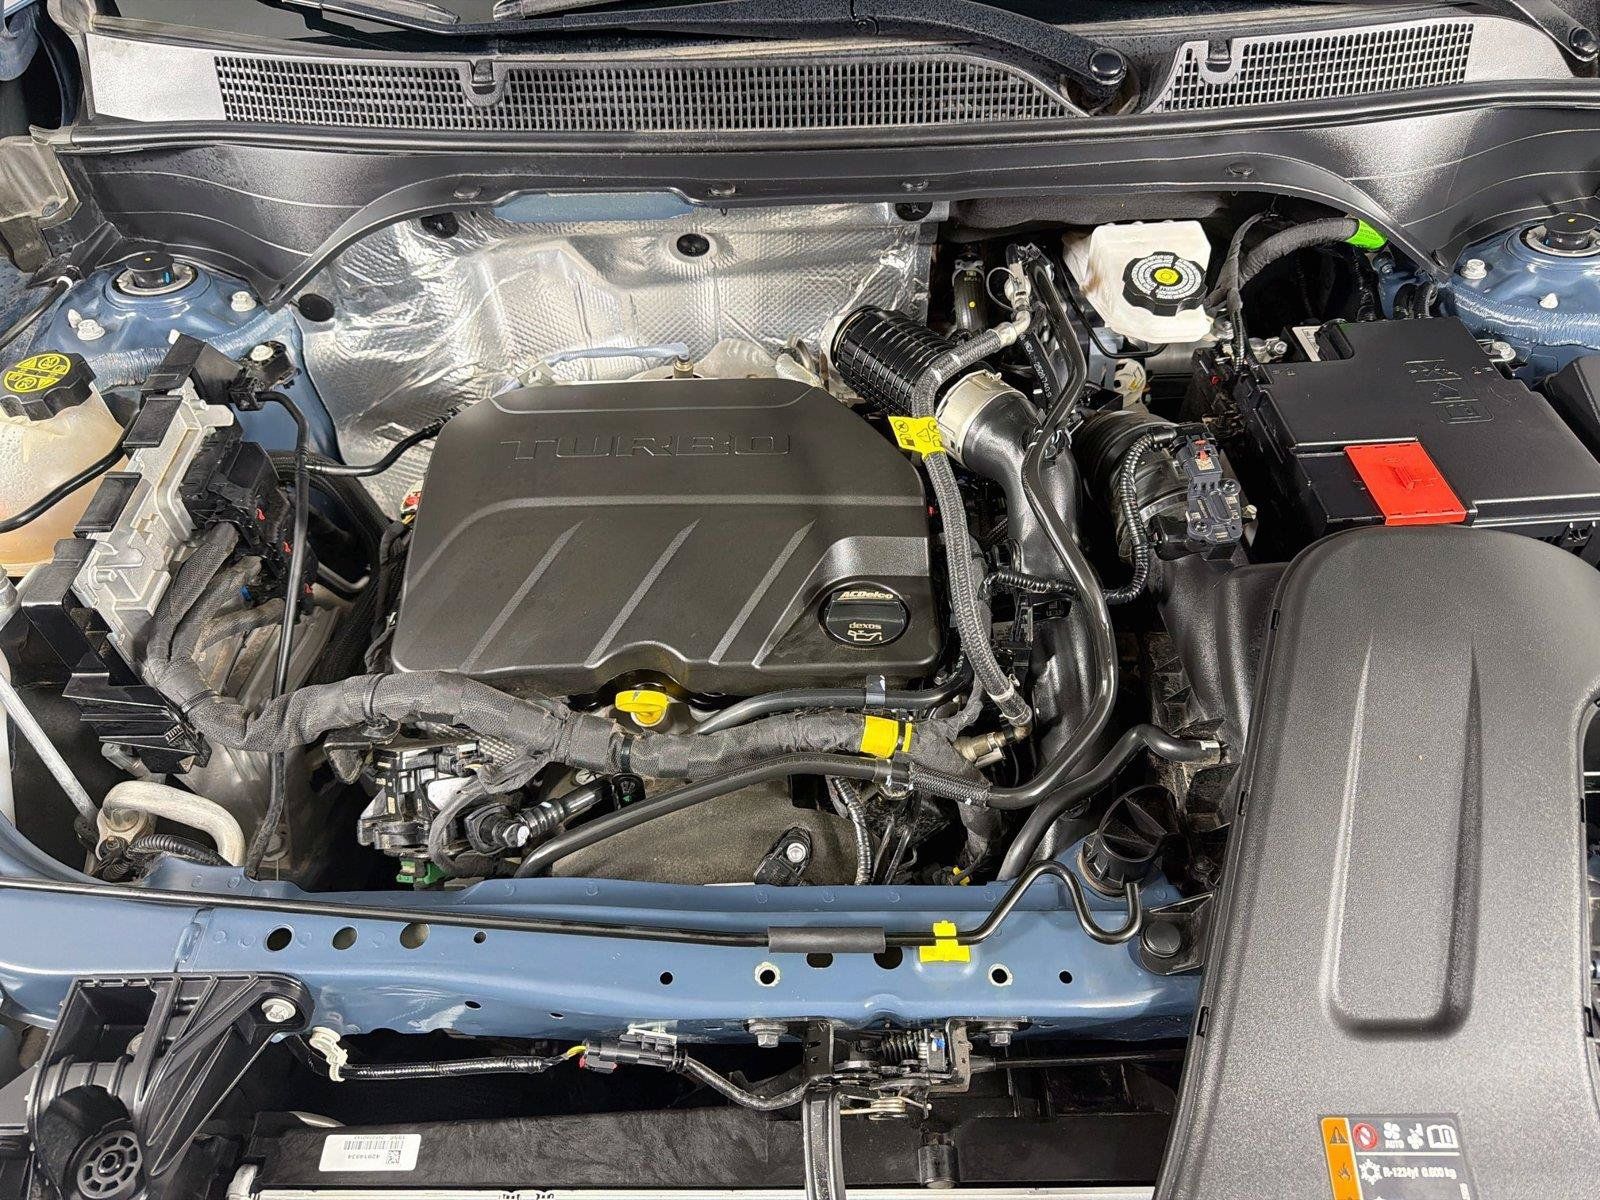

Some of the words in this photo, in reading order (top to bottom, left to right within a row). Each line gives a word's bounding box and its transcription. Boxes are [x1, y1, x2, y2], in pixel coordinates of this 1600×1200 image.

[500, 434, 791, 460] TURBO
[838, 590, 895, 601] ACDelco
[849, 622, 882, 630] dexos
[1385, 1139, 1405, 1149] AUTO
[1383, 1166, 1418, 1179] R-1234yf
[1444, 1167, 1458, 1180] kg
